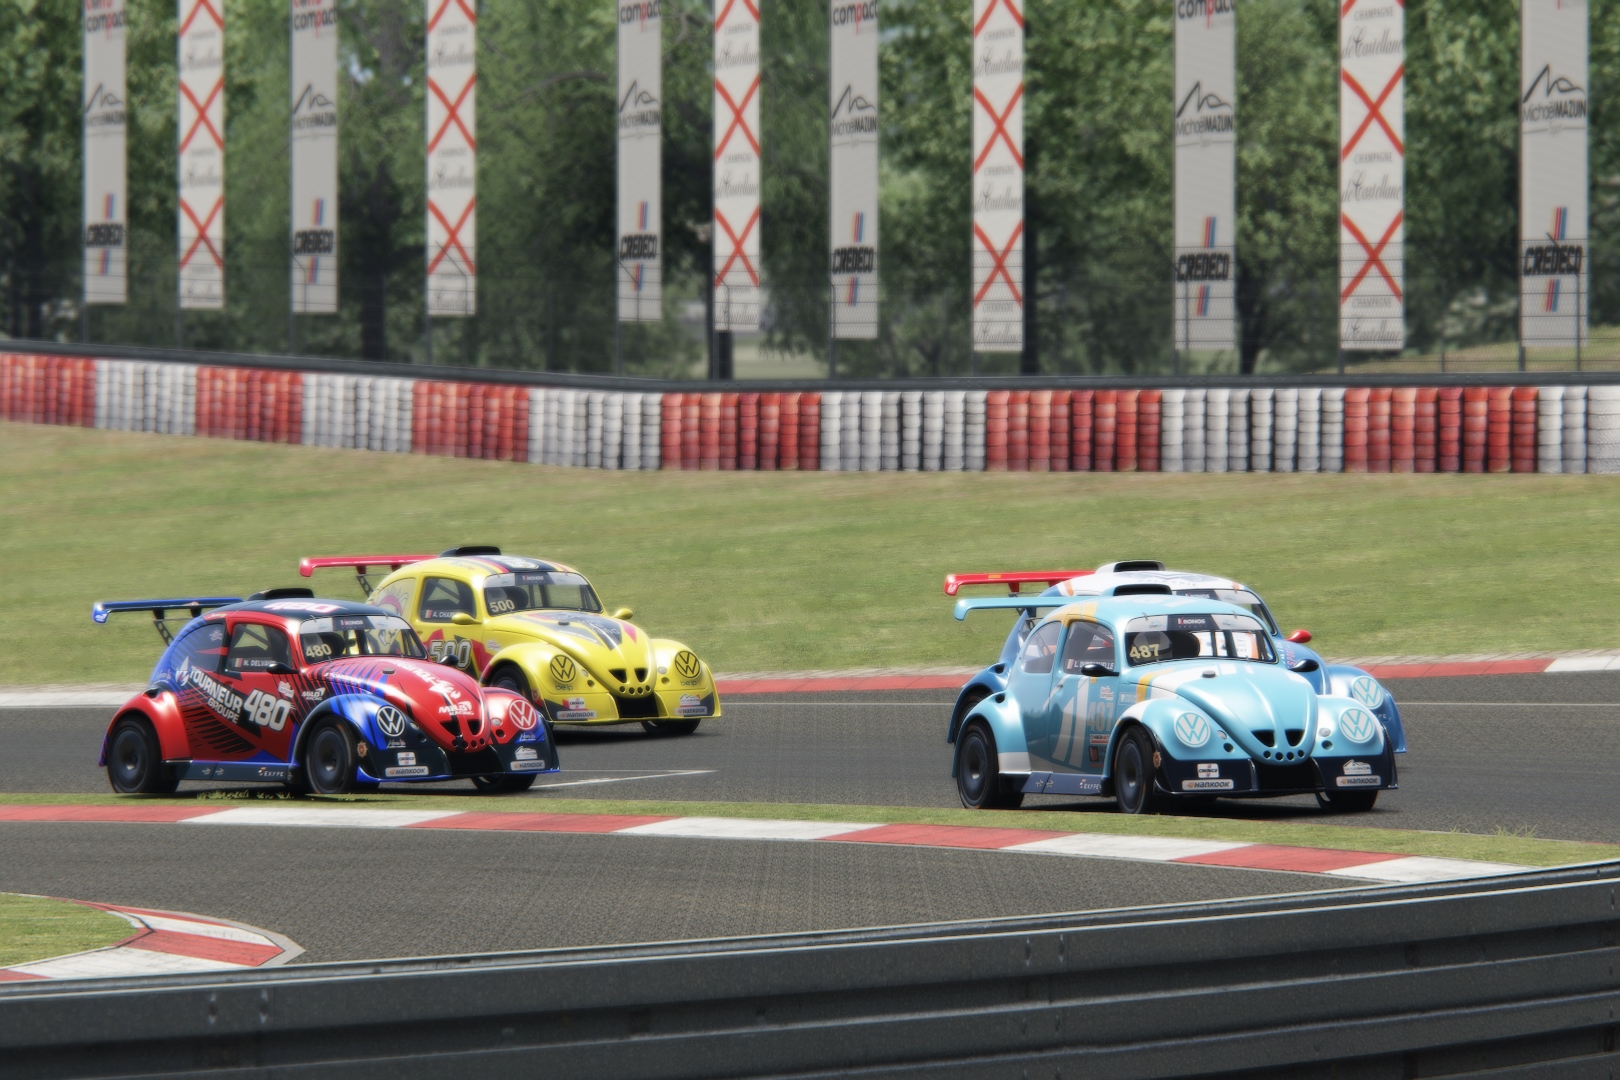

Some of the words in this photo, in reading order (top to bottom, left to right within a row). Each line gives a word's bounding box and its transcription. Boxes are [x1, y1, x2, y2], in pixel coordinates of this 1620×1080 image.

[1354, 6, 1394, 21] CHAMPAGNE
[1354, 152, 1393, 164] CHAMPAGNE
[293, 230, 334, 254] CREDECO
[619, 234, 658, 261] CREDECO
[832, 246, 874, 274] CREDECO
[1177, 252, 1230, 281] CREDECO
[1523, 245, 1583, 275] CREDECO
[490, 600, 516, 612] 500
[1178, 617, 1206, 625] KRONOS
[305, 643, 332, 658] 480
[1129, 643, 1160, 659] 487
[189, 665, 243, 713] TOURNEUR
[208, 697, 240, 724] GROUPE
[243, 688, 291, 732] 480
[1087, 701, 1115, 732] 487
